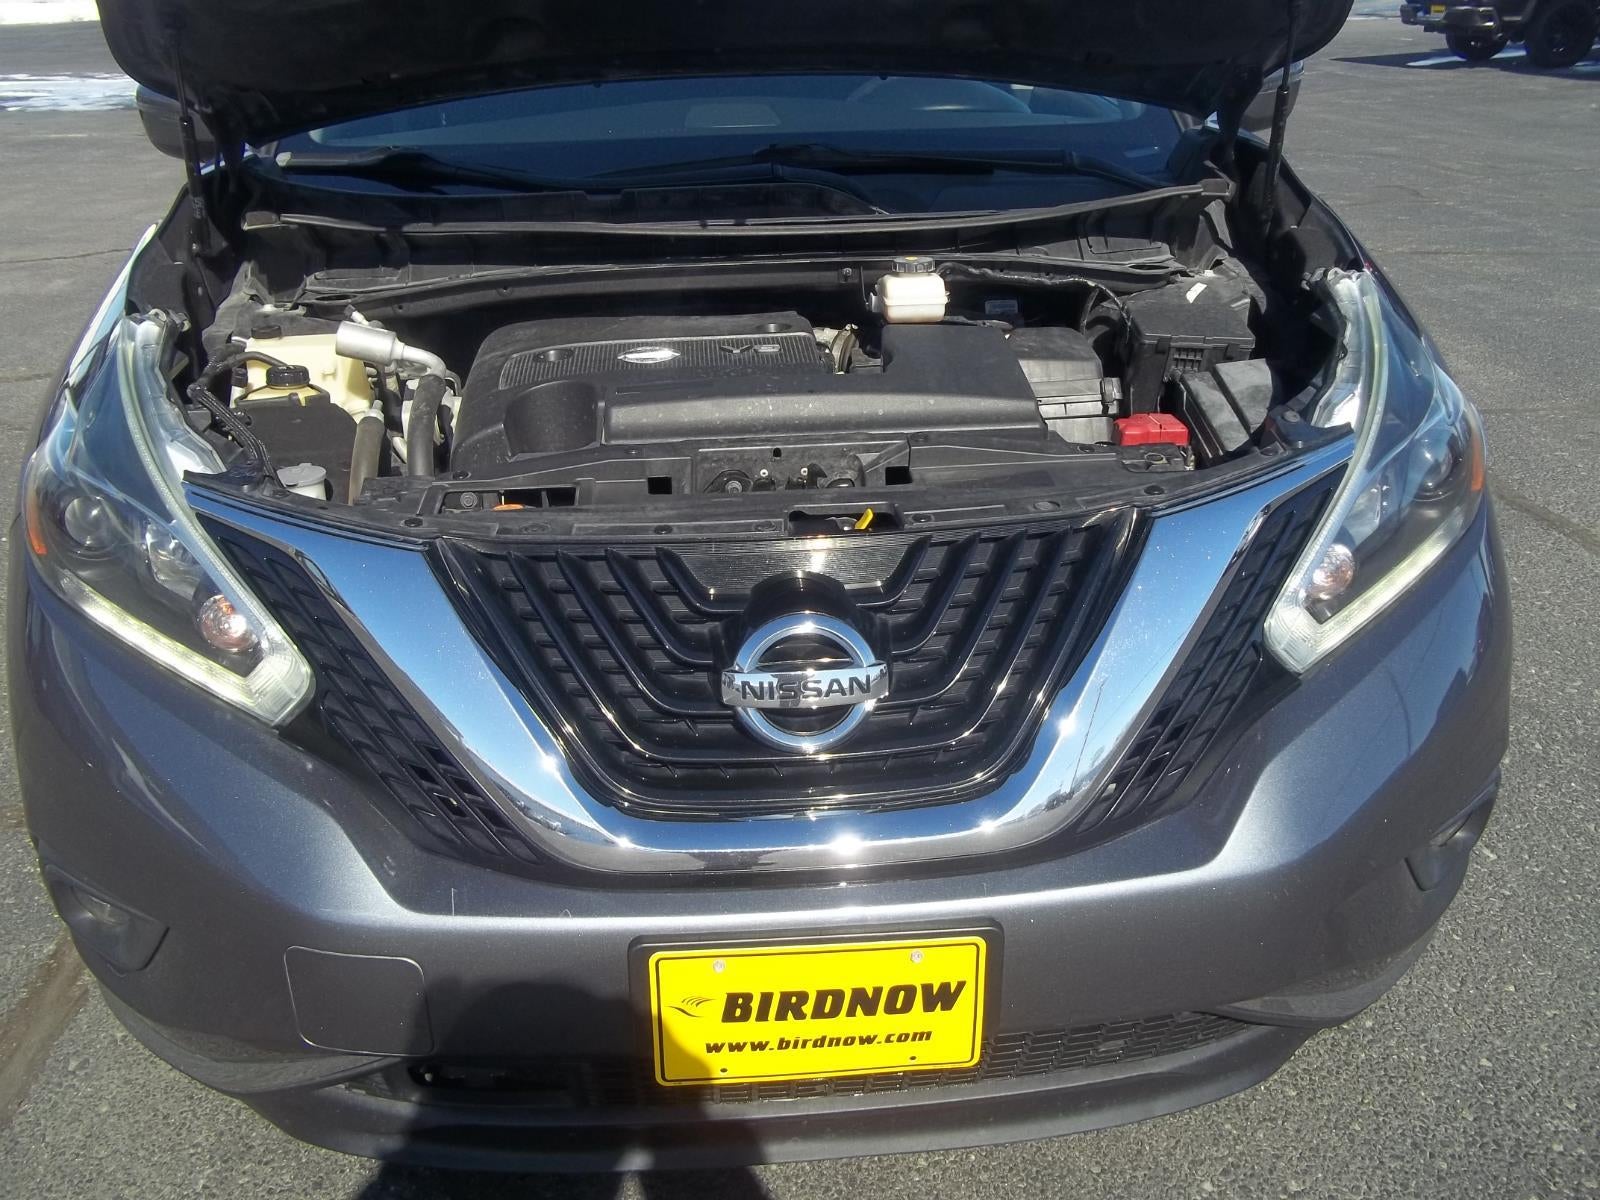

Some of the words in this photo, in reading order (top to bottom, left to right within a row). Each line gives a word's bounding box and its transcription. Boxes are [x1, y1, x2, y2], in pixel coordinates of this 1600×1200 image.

[741, 674, 871, 700] NISSAN
[721, 980, 967, 1023] BIRDNOW
[705, 1029, 933, 1054] www.birdnow.com
